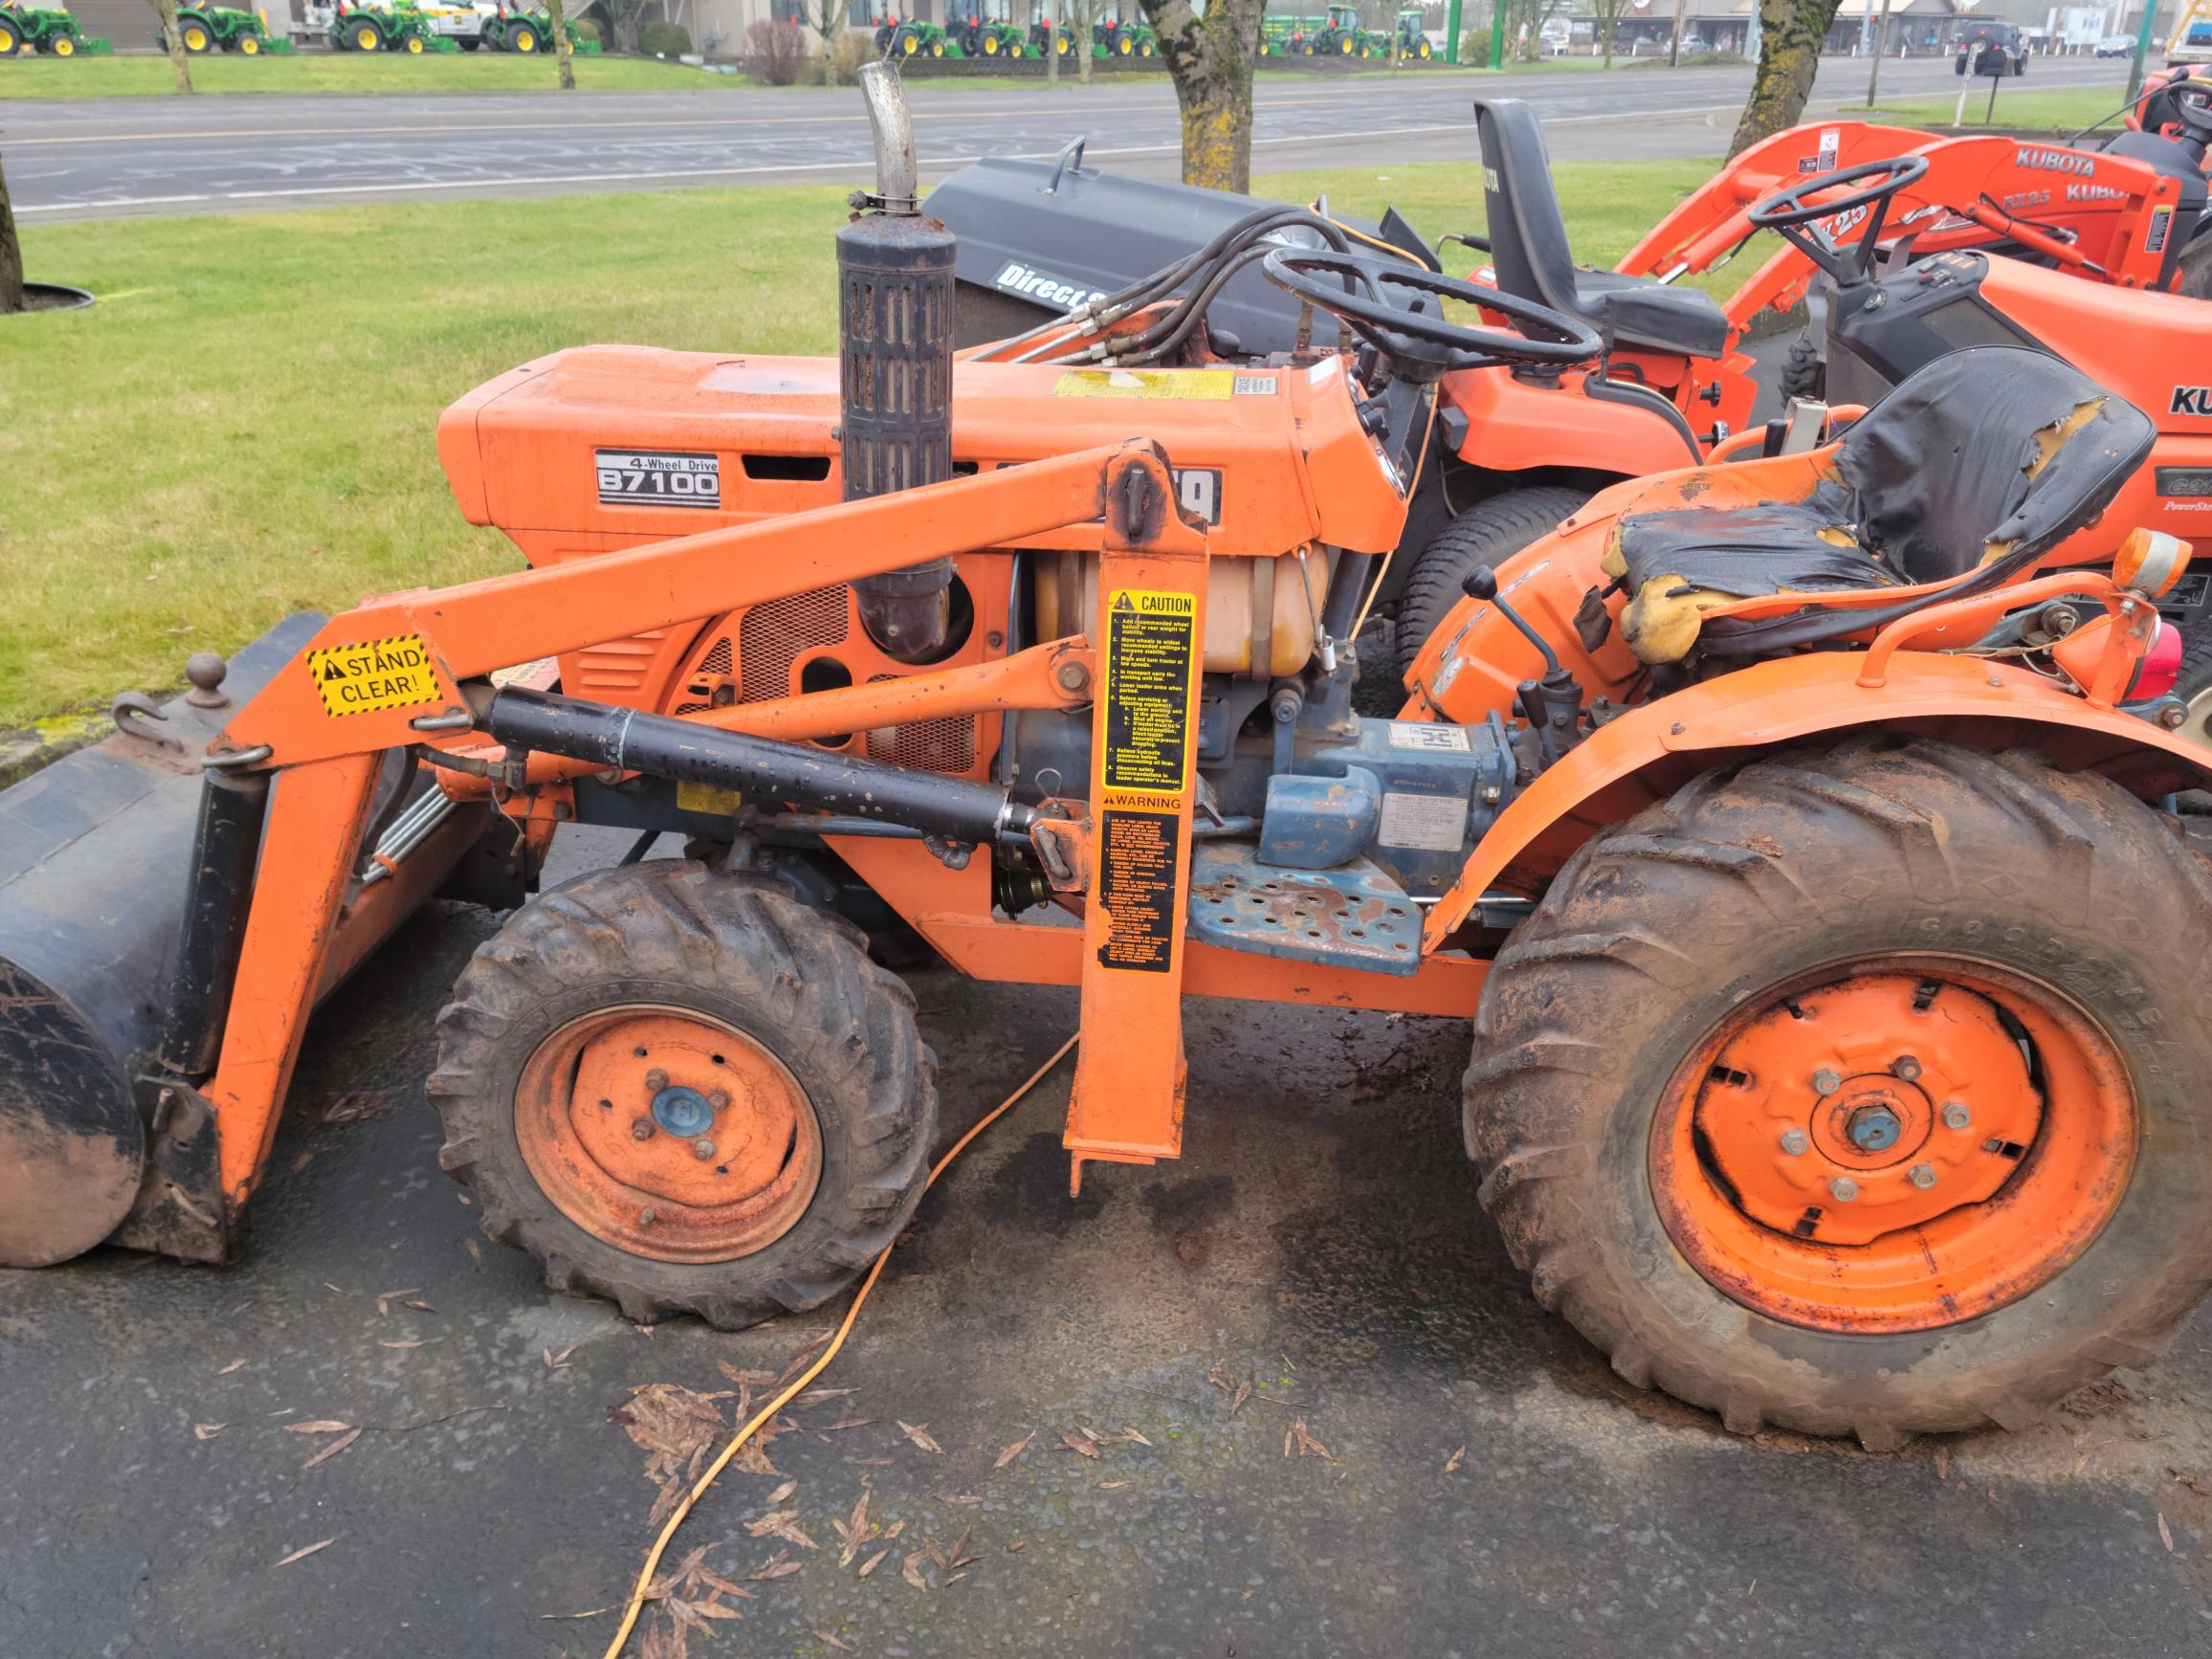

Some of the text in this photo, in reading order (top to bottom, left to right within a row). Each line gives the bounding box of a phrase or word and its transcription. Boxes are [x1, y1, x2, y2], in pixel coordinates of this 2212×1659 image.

[2015, 147, 2095, 179] KUBOTA
[689, 460, 718, 471] Drive
[598, 469, 719, 495] B7100
[1141, 596, 1191, 612] CAUTION
[347, 649, 421, 676] STAND
[341, 675, 420, 703] CLEAR!
[1116, 795, 1181, 809] WARNING
